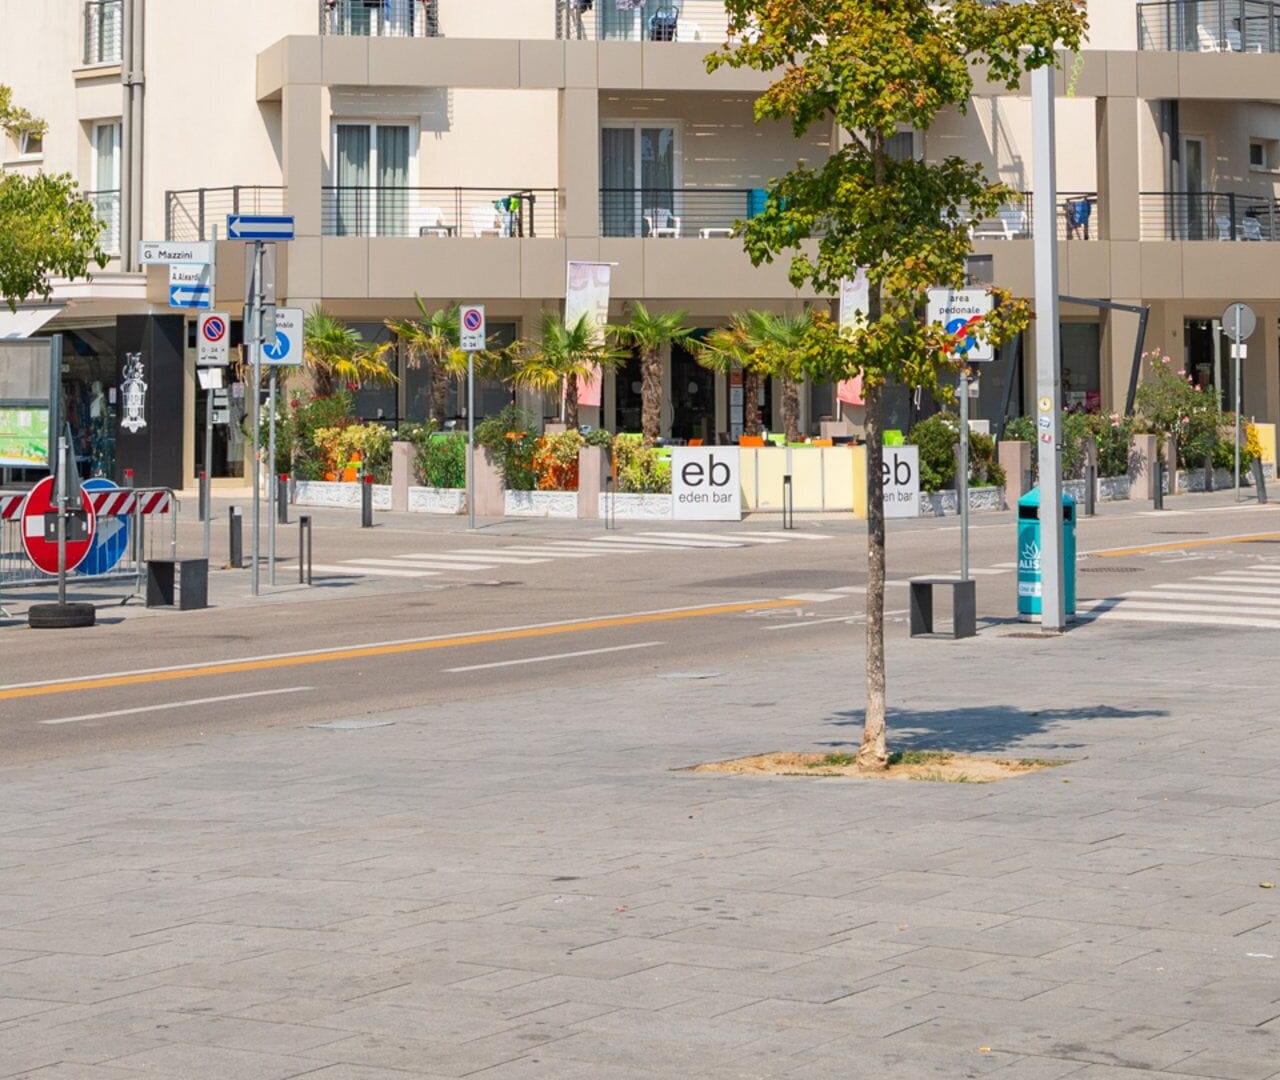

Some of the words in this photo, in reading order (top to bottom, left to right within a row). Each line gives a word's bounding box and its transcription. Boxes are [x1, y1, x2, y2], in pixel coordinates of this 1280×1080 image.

[158, 250, 193, 259] Mazzini
[939, 306, 981, 315] pedonale
[681, 453, 731, 487] eb
[678, 491, 709, 504] eden
[712, 491, 732, 504] bar
[882, 492, 896, 502] en
[897, 490, 913, 502] bar
[1018, 559, 1040, 569] ALIS
